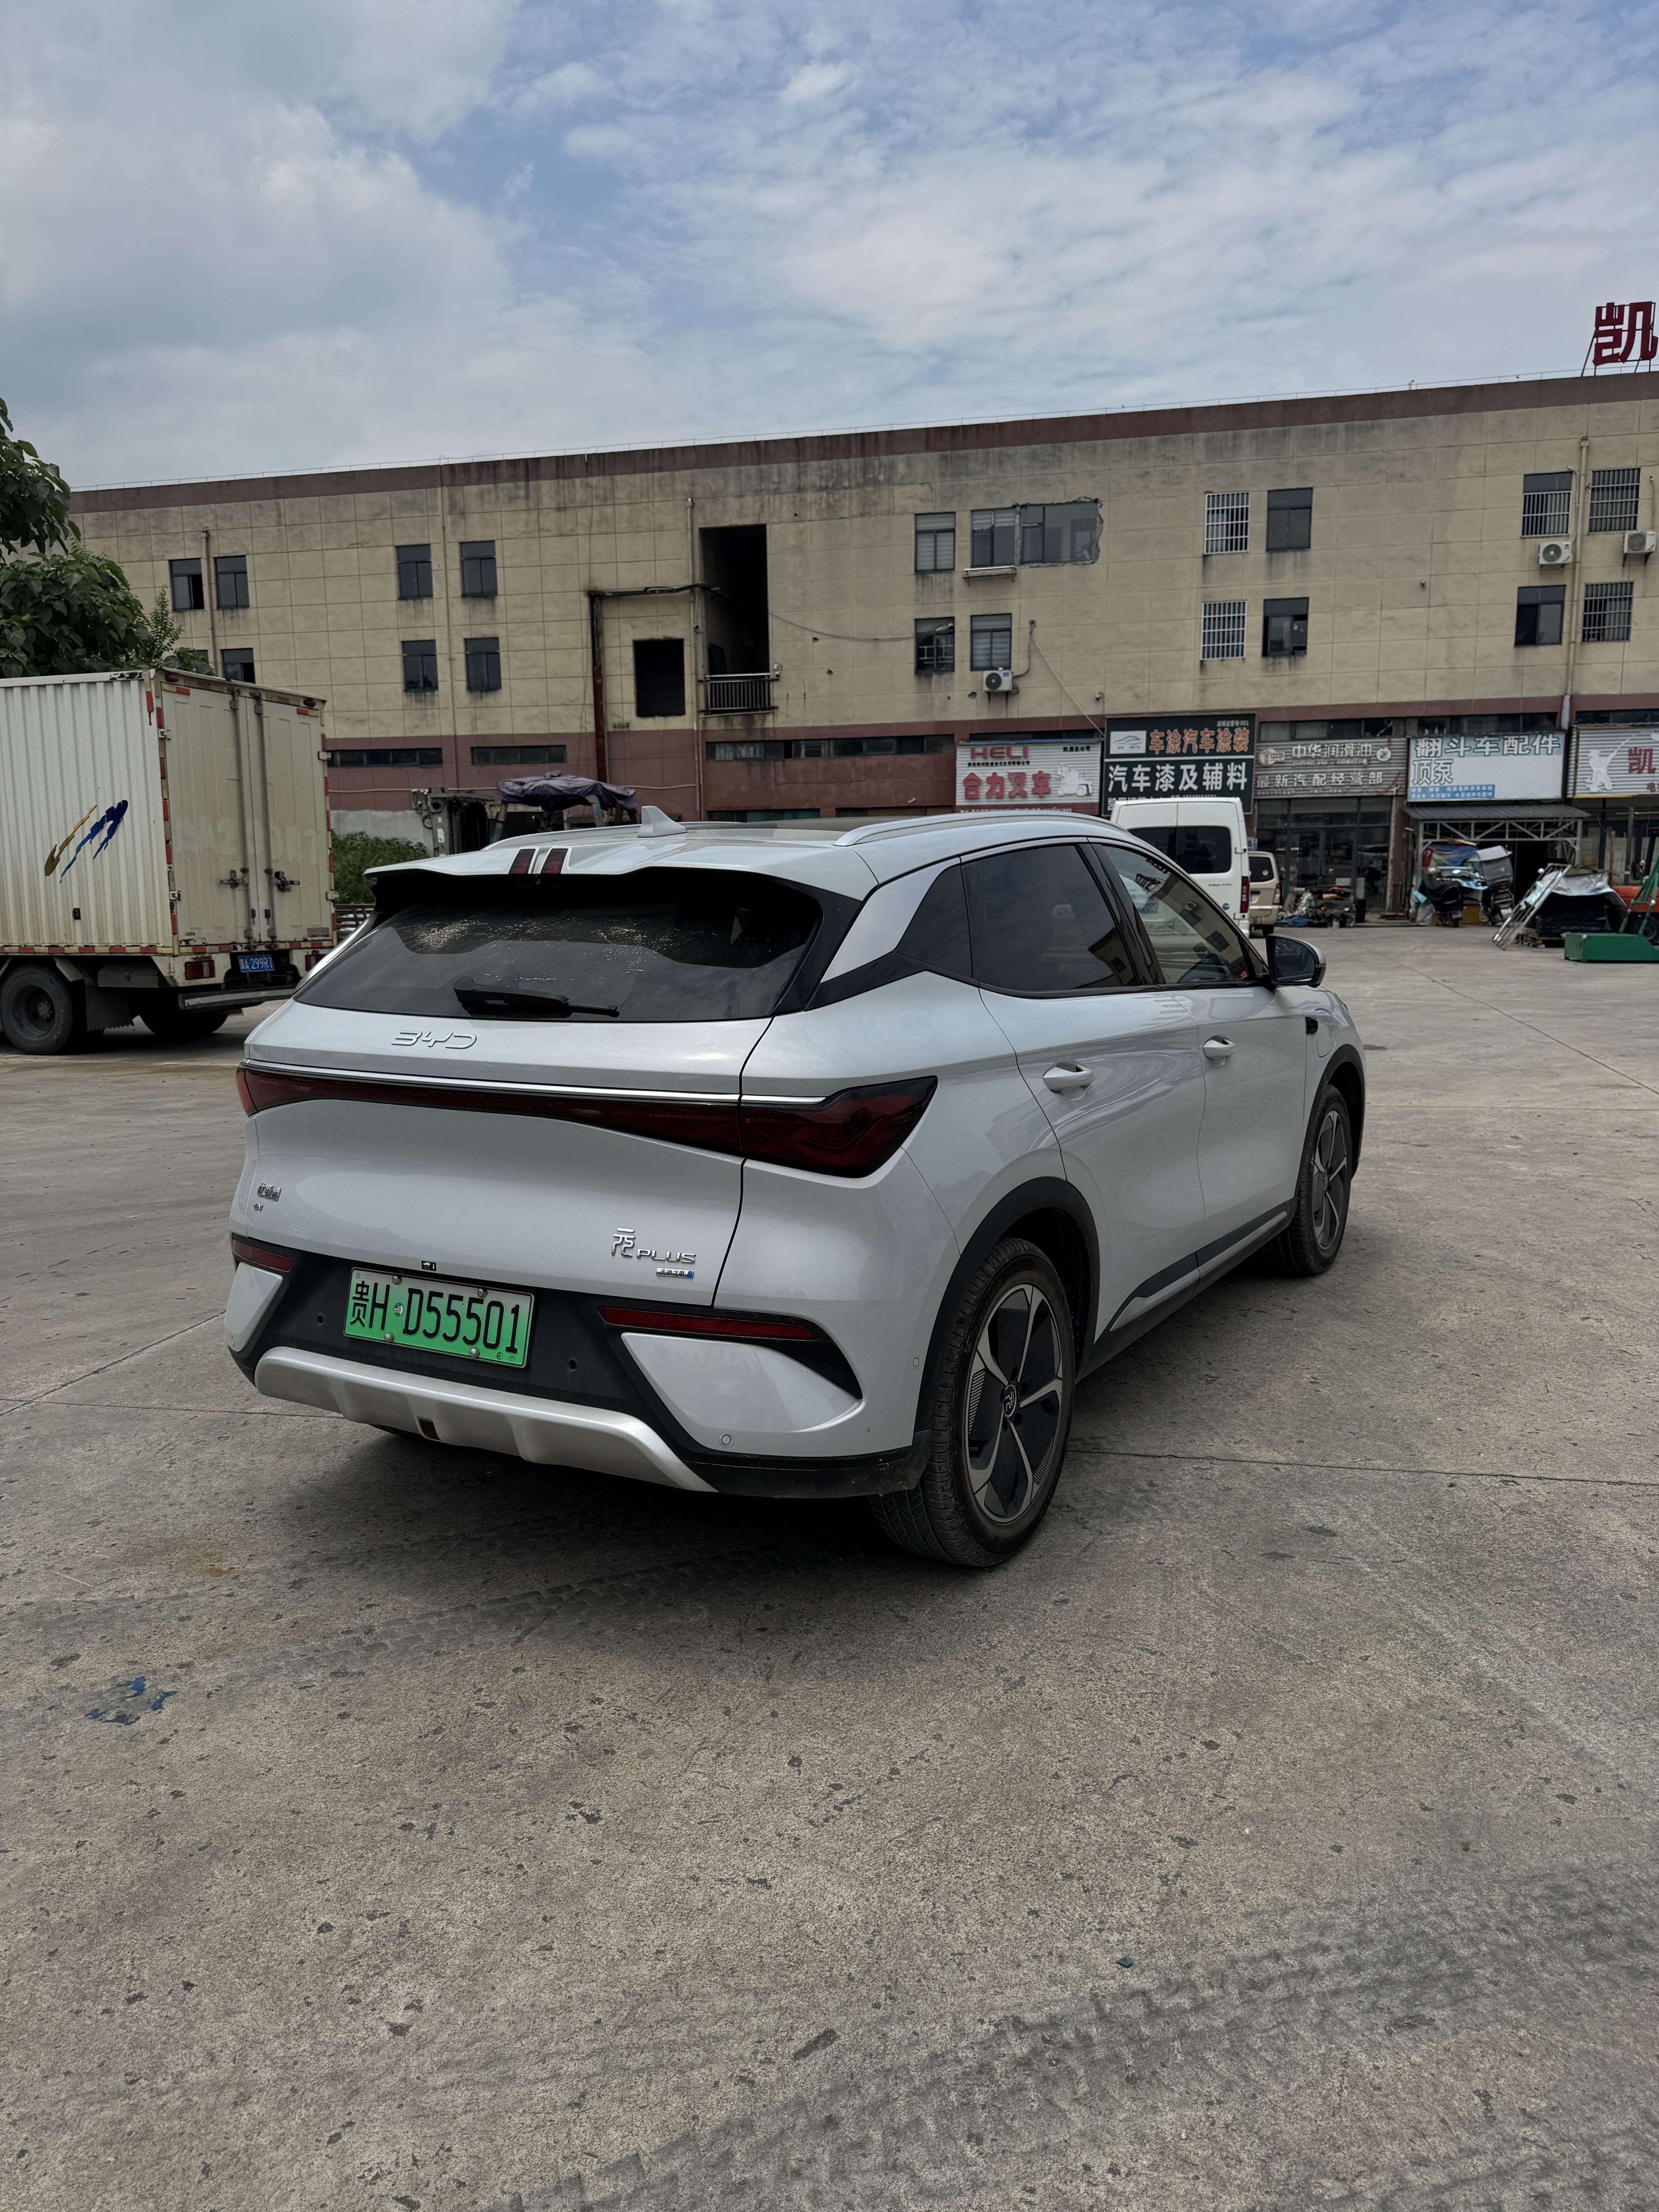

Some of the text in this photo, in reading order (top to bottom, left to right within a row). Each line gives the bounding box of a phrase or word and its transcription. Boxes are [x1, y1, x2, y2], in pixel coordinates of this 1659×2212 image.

[1592, 301, 1658, 366] 凯
[970, 746, 1028, 759] HELI
[1149, 728, 1250, 755] 车涂汽车涂装
[1292, 743, 1372, 758] 中华润滑油
[1415, 733, 1561, 758] 翻斗车配件
[1412, 758, 1453, 785] 顶泵
[1628, 747, 1657, 774] 凯
[963, 770, 1051, 800] 合力叉车
[1108, 762, 1248, 793] 汽车漆及辅料
[1257, 772, 1382, 788] 最新汽配经营部
[391, 1030, 477, 1049] BYD
[637, 1248, 697, 1264] PLUS
